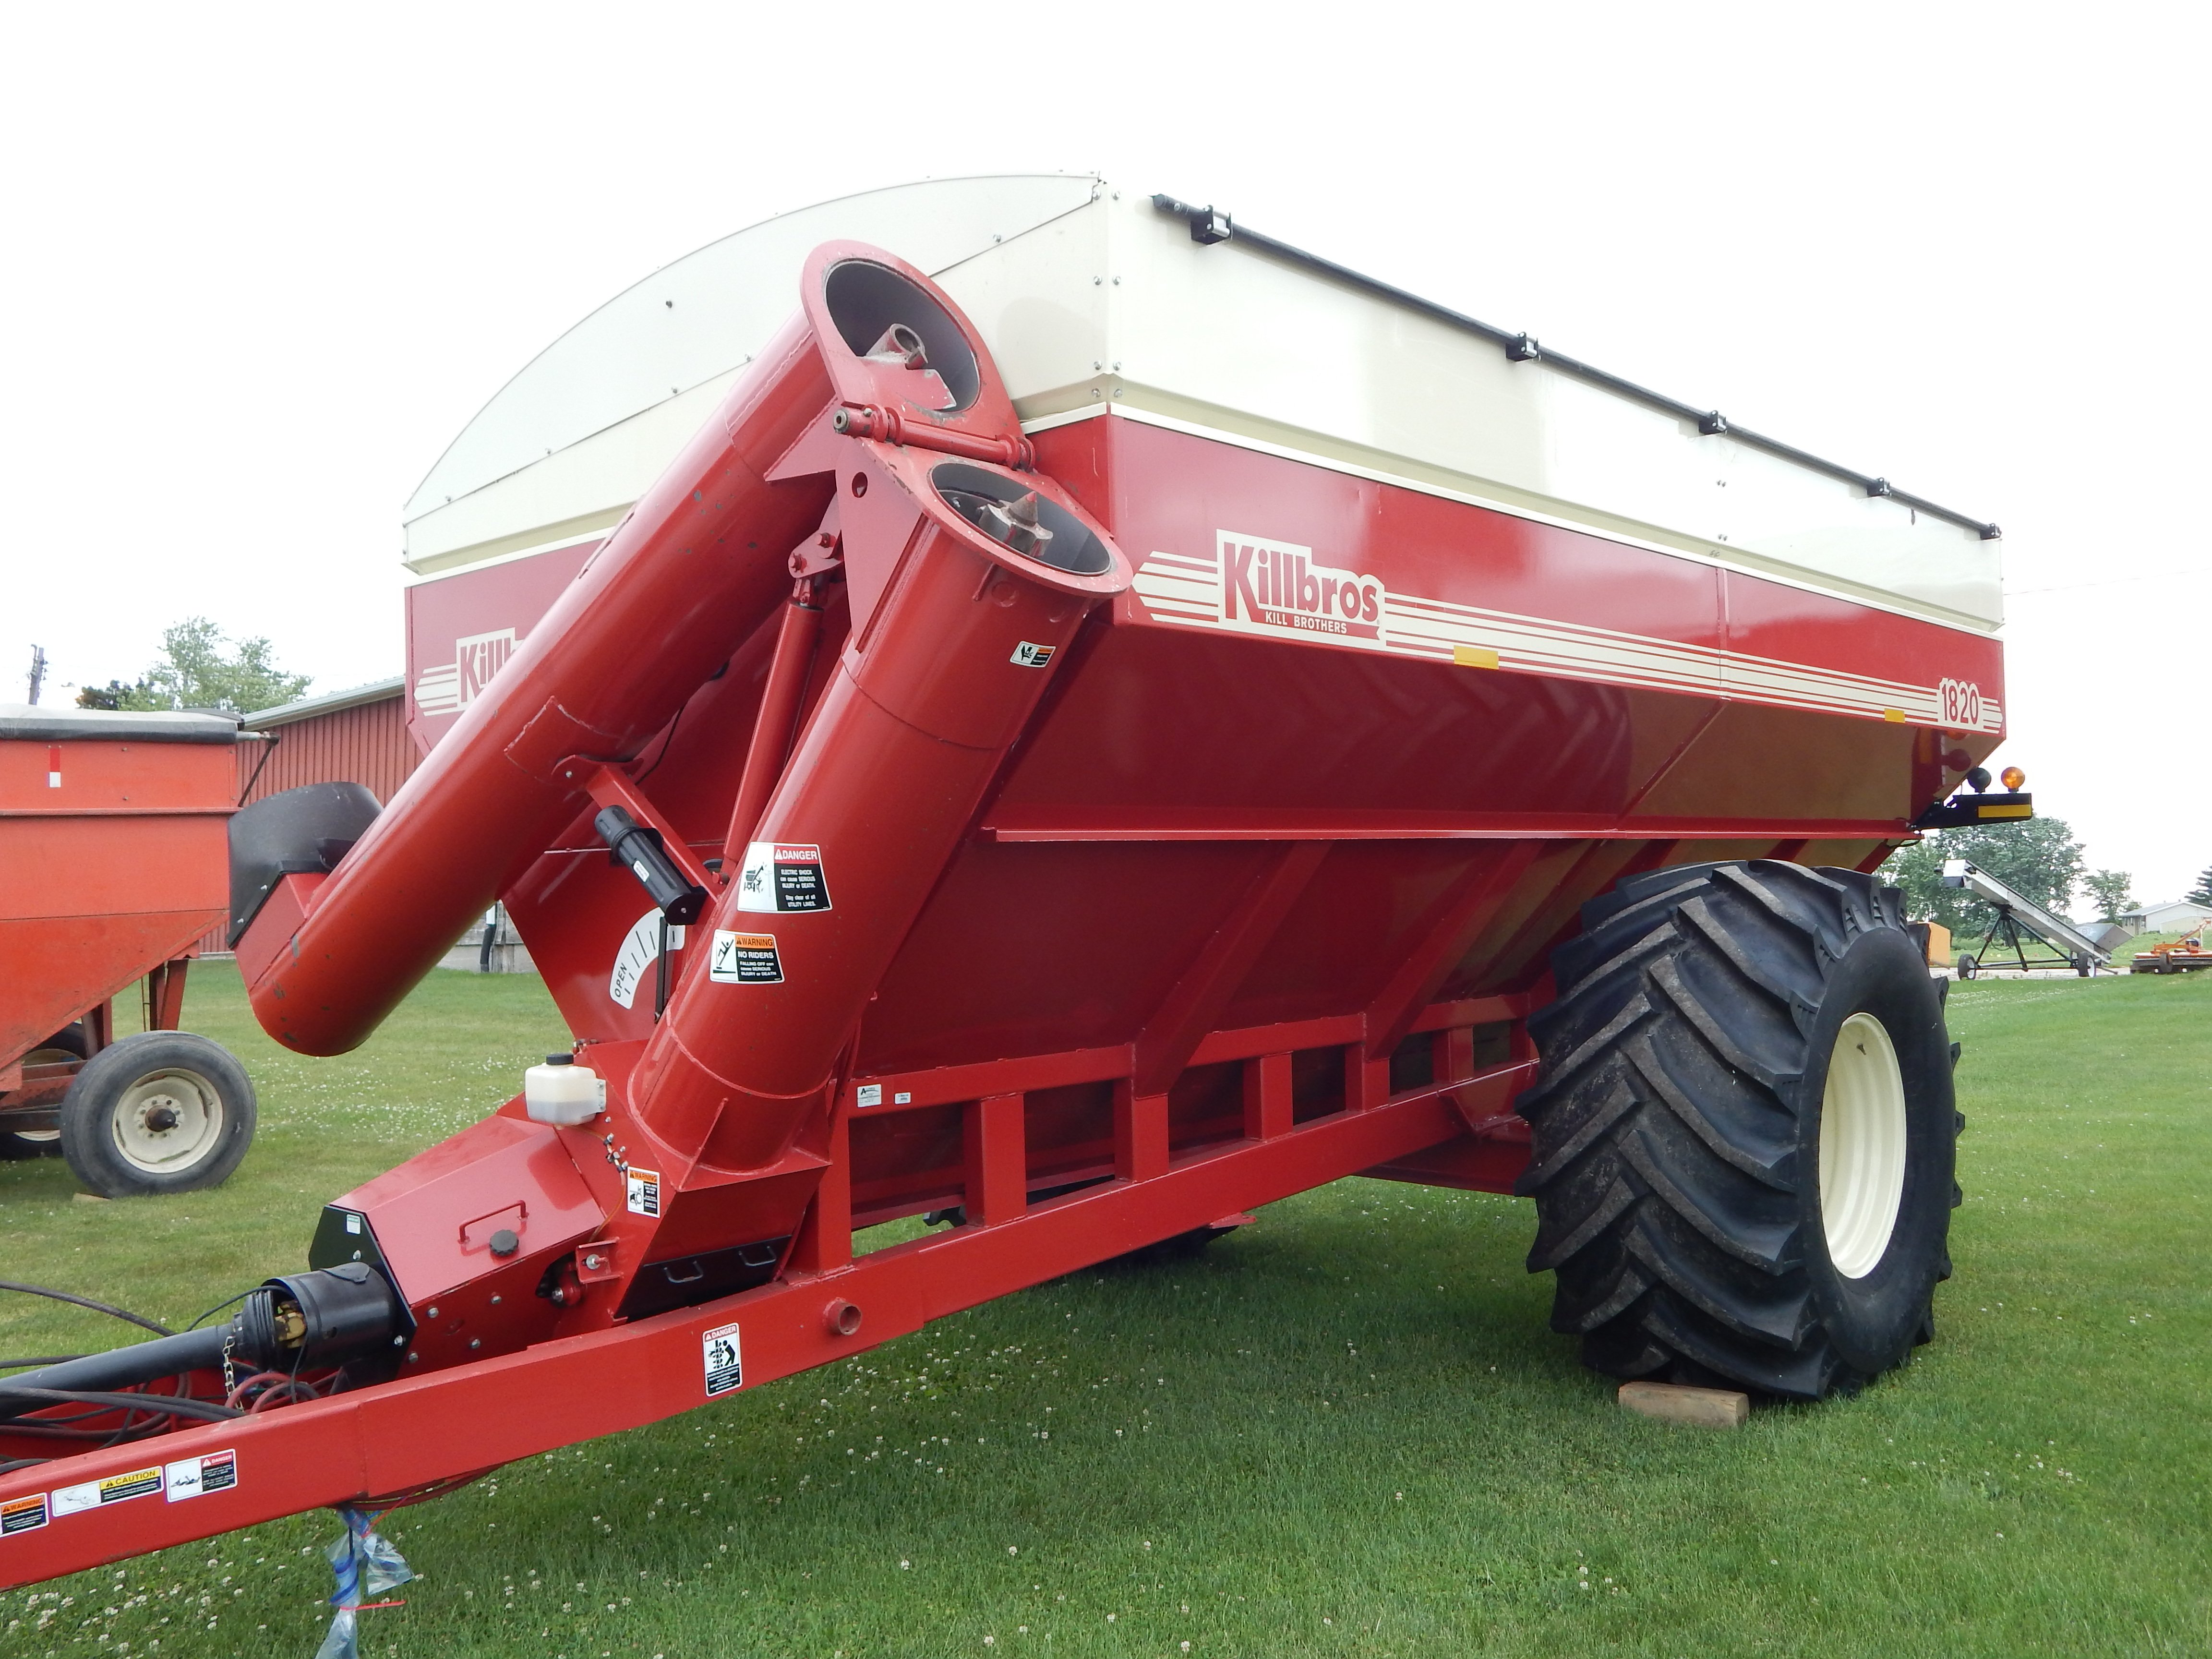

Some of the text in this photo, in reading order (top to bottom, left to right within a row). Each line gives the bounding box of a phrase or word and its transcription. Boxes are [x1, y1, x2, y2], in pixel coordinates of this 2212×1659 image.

[1224, 541, 1379, 622] Killbros
[1265, 611, 1347, 634] KILL BROTHERS
[1941, 683, 1979, 725] 1820
[782, 850, 817, 860] DANGER
[742, 938, 773, 946] WARNING
[614, 962, 627, 998] OPEN
[634, 1172, 657, 1182] WARNING
[711, 1325, 736, 1338] DANGER
[211, 1455, 232, 1464] DANGER
[115, 1470, 156, 1485] CAUTION
[10, 1498, 43, 1510] WARNING
